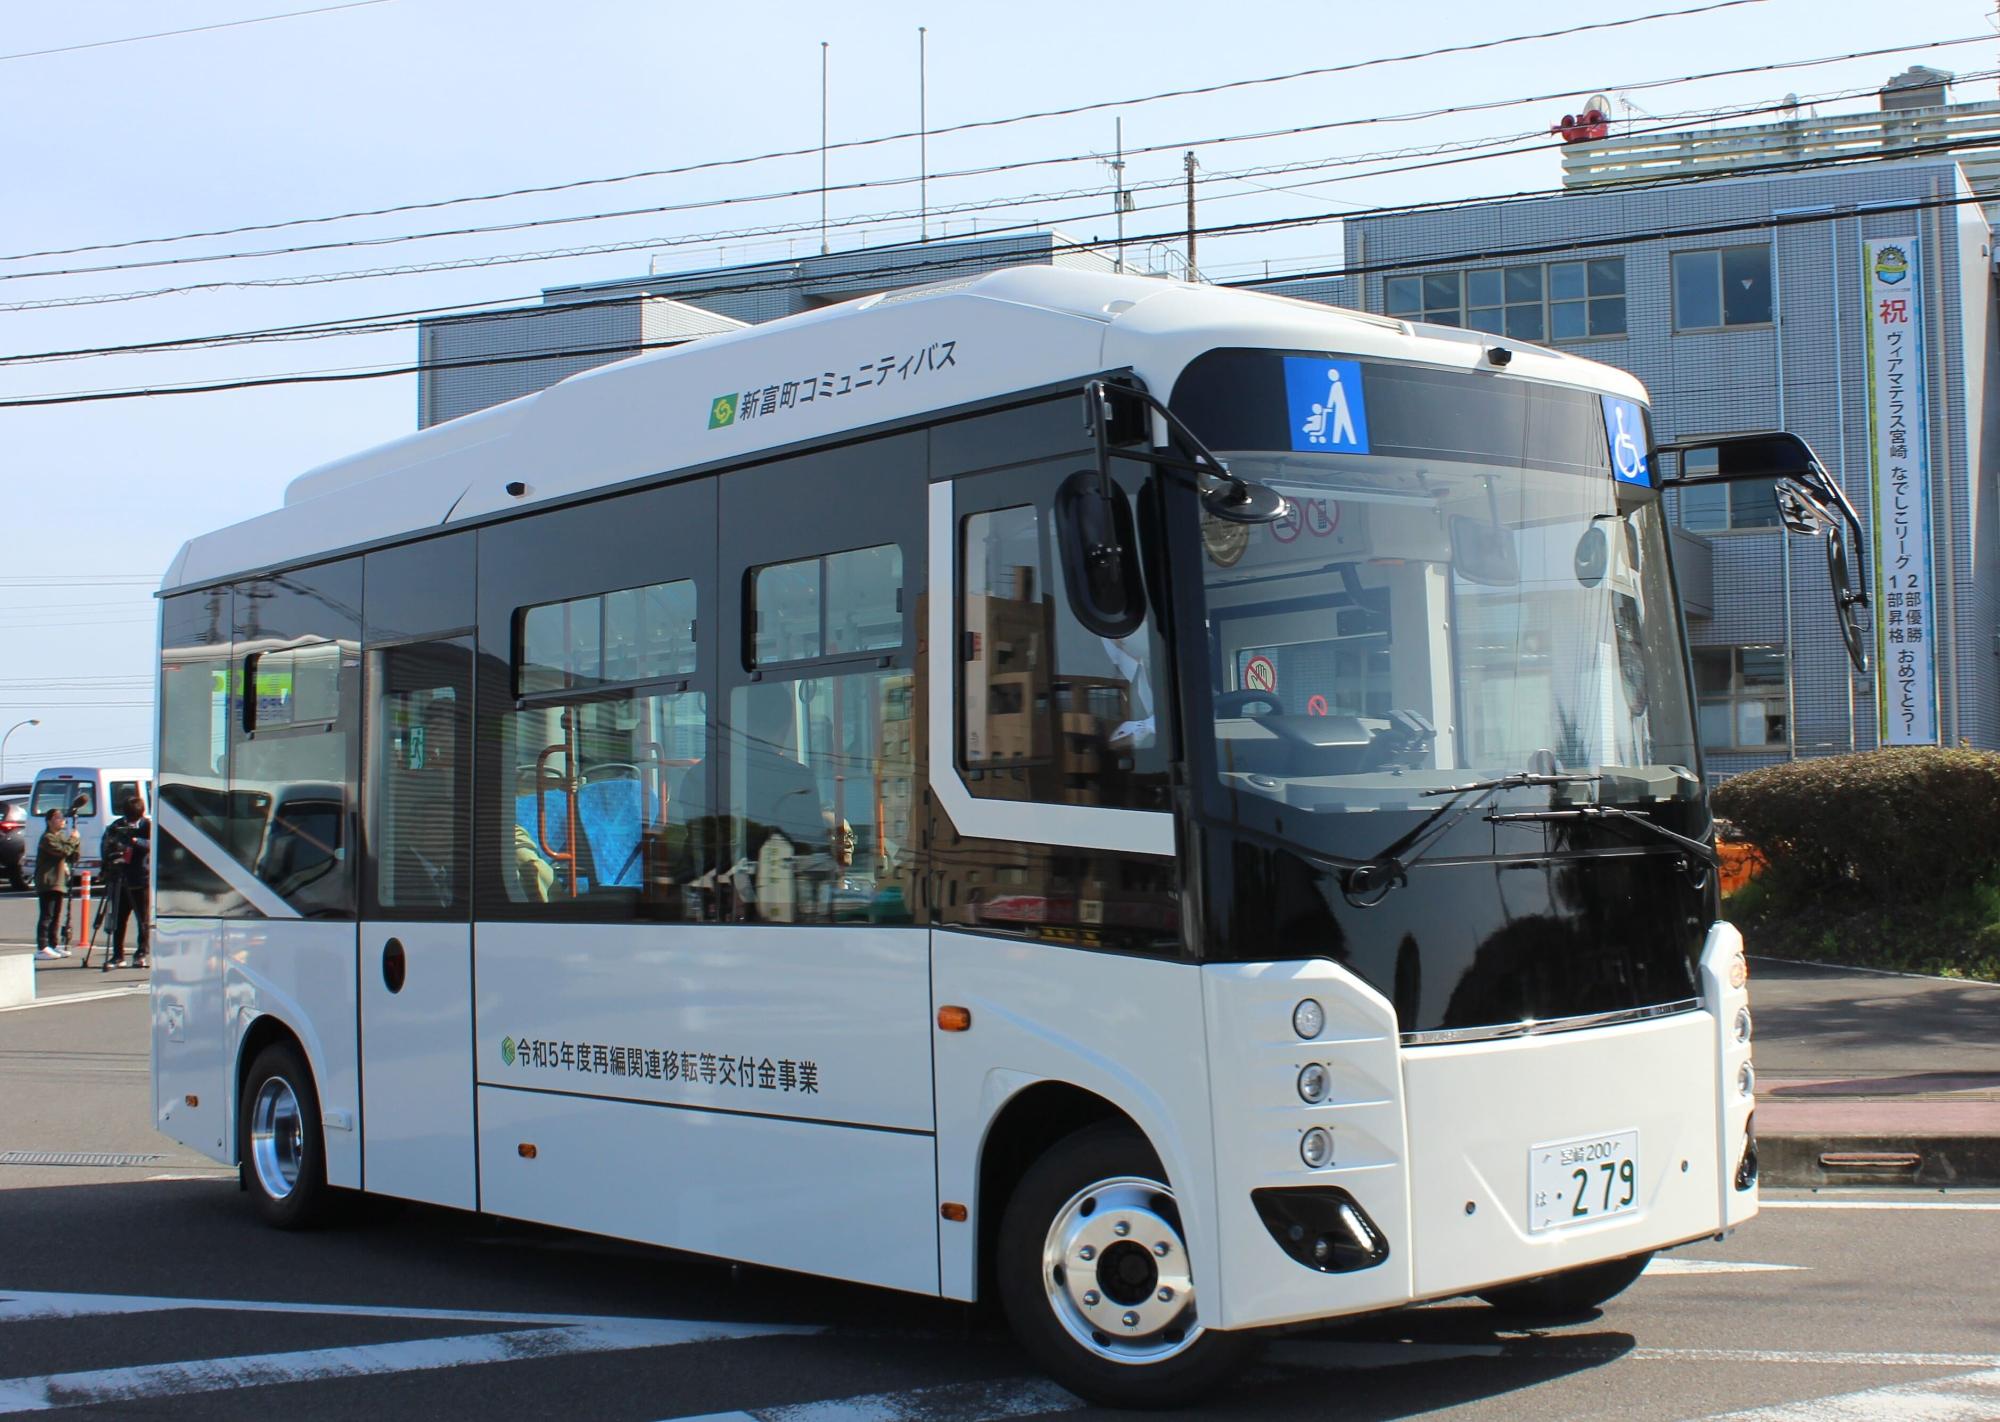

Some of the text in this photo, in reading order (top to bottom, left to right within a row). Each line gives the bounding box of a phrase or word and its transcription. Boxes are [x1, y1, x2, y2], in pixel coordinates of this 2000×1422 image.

[1879, 299, 1908, 325] 祝
[739, 340, 957, 422] 新富町コミュニティバス
[1886, 331, 1912, 570] ヴィアマテラス宮崎 なでしこリーグ
[1887, 575, 1904, 644] 1部昇格
[1906, 574, 1923, 643] 2部優勝
[516, 1037, 819, 1095] 令和5年度再編関連移転等交付金事業
